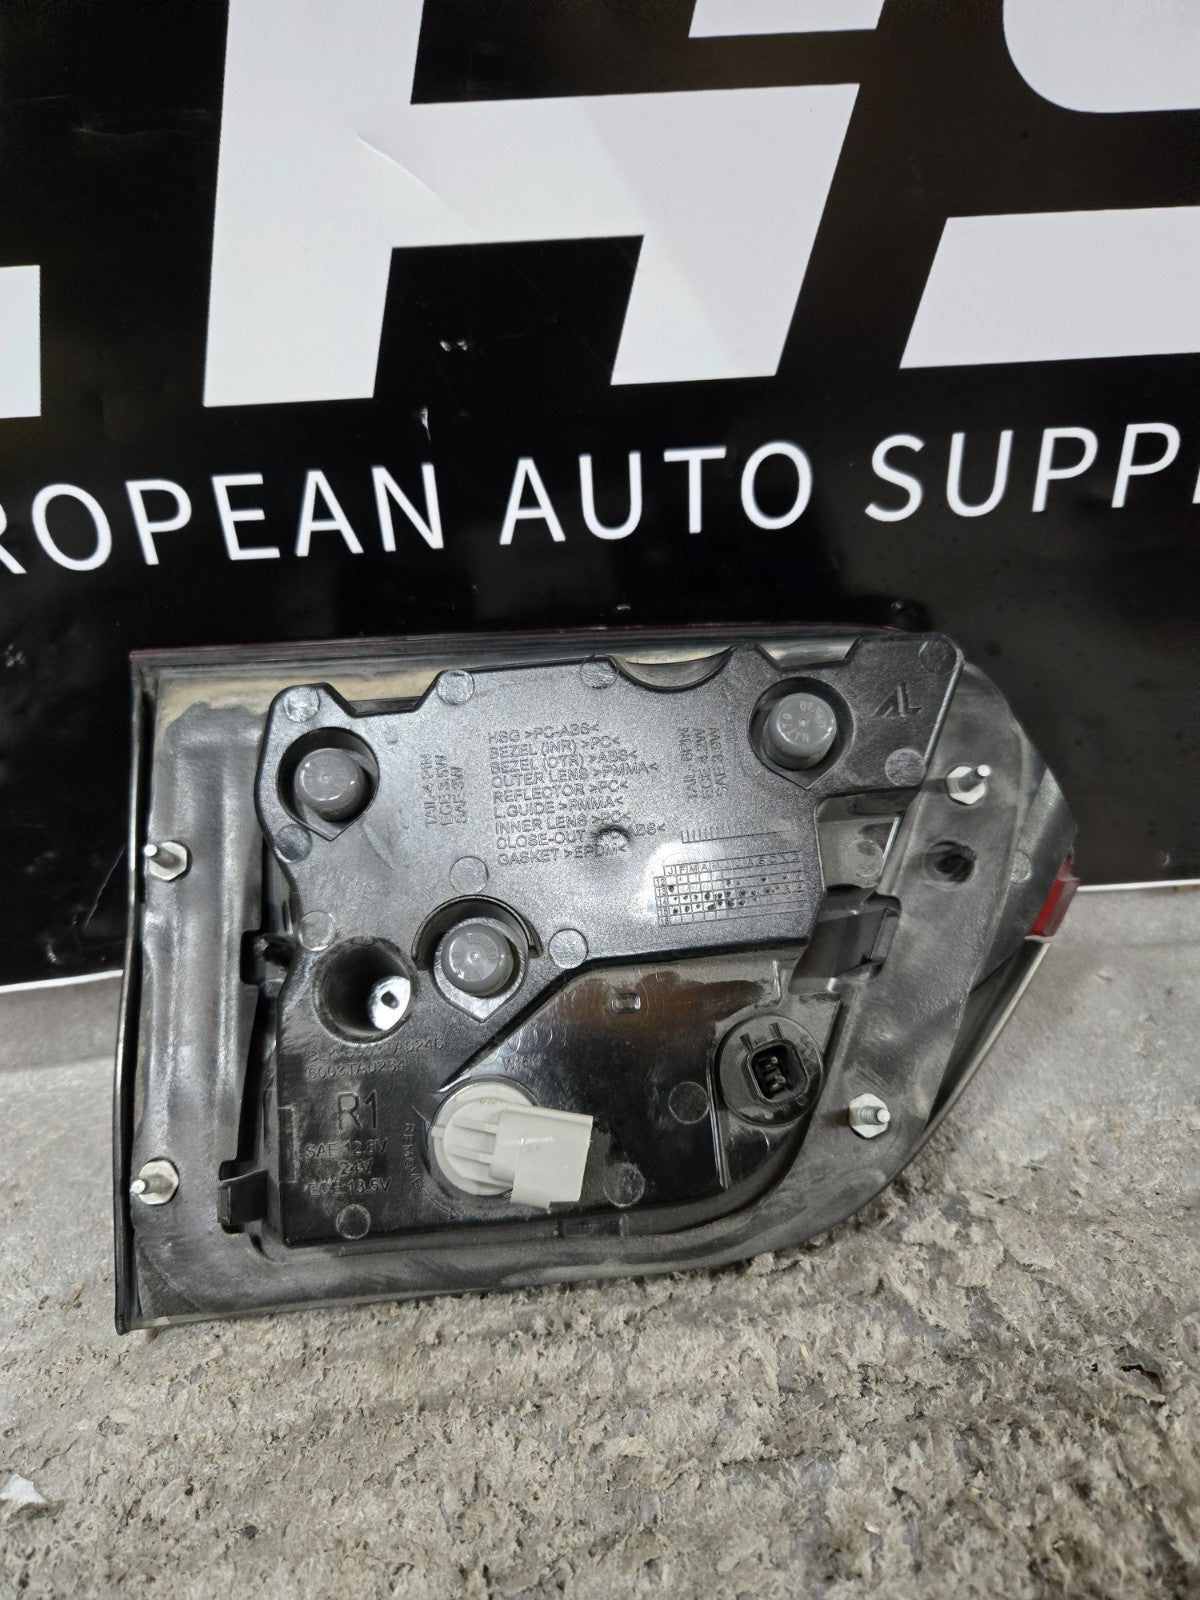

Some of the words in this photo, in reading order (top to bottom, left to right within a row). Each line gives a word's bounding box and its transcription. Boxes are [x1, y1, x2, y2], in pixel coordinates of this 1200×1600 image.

[499, 441, 813, 546] AUTO
[864, 421, 1200, 522] SUPP
[488, 729, 521, 745] HSG
[489, 744, 537, 760] BEZEL
[490, 758, 538, 774] BEZEL
[491, 771, 545, 788] OUTER
[550, 767, 589, 783] LENS
[493, 783, 585, 804] REFLECTOR
[494, 802, 556, 819] L.GUIDE
[495, 818, 543, 835] INNER
[547, 814, 588, 830] LENS
[496, 829, 586, 850] CLOSE-OUT
[498, 848, 560, 867] GASKET
[338, 1089, 377, 1132] R1
[402, 1121, 423, 1191] REMOVE
[340, 1158, 374, 1176] 24V
